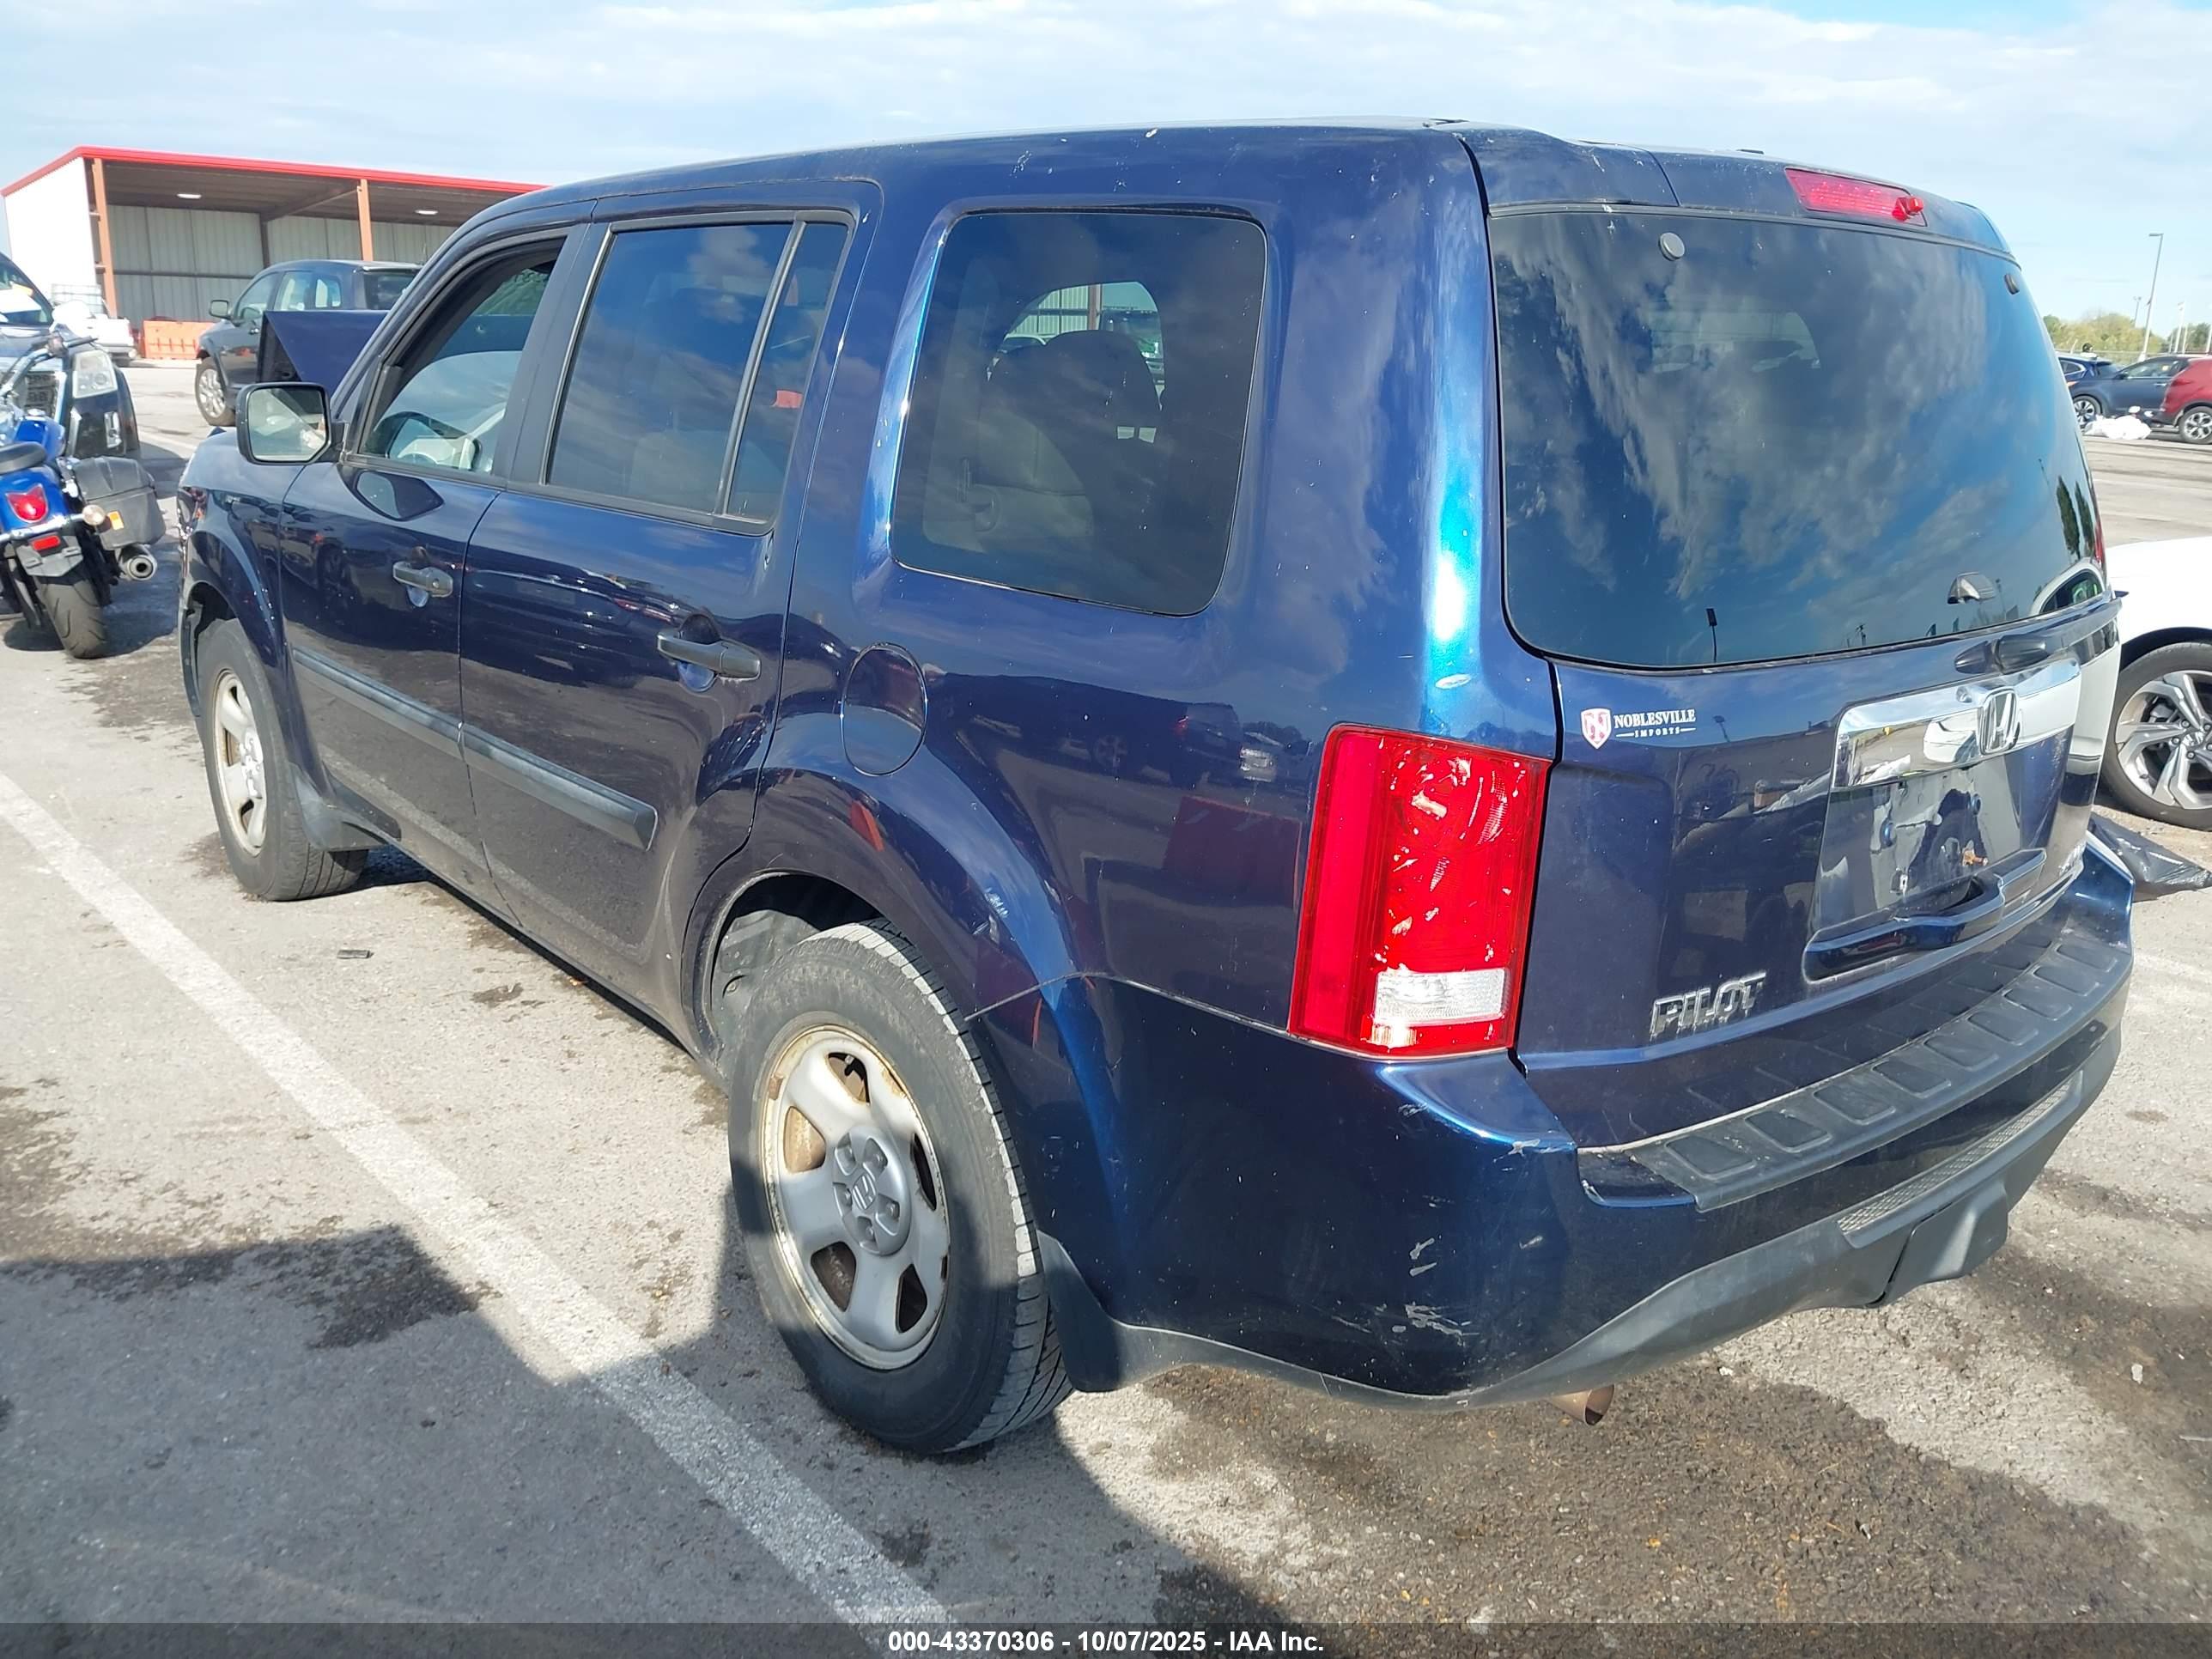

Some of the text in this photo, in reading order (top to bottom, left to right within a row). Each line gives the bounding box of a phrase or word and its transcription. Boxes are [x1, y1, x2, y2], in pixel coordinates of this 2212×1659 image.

[1613, 708, 1696, 729] NOBLESVILLE
[1634, 727, 1680, 738] IMPORTS
[1650, 971, 1766, 1039] PILOT
